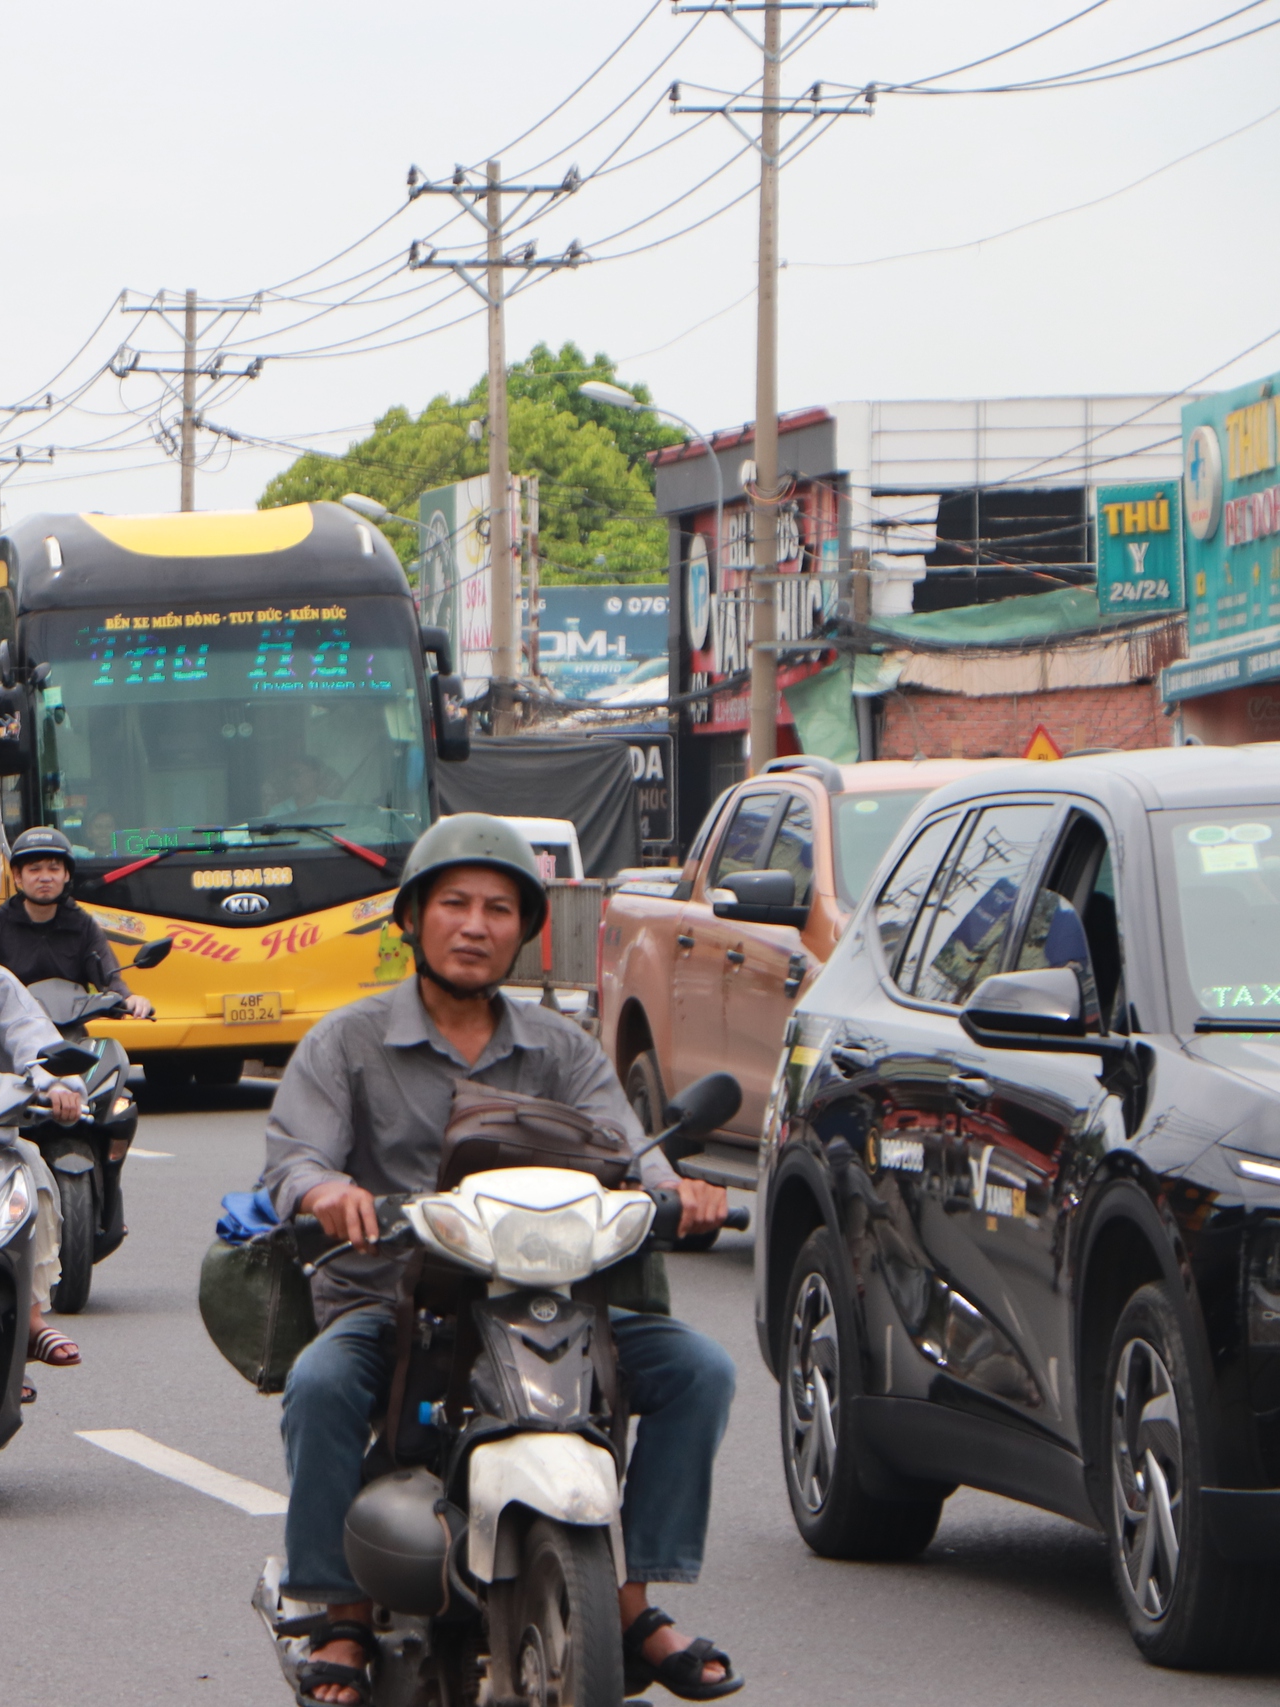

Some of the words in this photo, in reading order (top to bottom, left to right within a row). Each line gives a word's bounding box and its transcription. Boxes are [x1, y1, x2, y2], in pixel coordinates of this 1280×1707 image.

[1103, 493, 1170, 536] THÚ
[1129, 542, 1149, 574] Y
[1110, 579, 1170, 601] 24/24
[627, 596, 669, 612] 076
[105, 613, 131, 630] BẾN
[133, 617, 150, 629] XE
[185, 611, 221, 627] ĐÔNG
[229, 611, 254, 624] TUY
[256, 607, 283, 622] ĐỨC
[290, 605, 319, 621] KIẾN
[321, 604, 347, 620] ĐỨC
[574, 663, 622, 674] HYBRID
[629, 745, 665, 781] DA
[192, 869, 233, 889] 0905
[263, 866, 293, 886] 333
[229, 898, 262, 913] KIA
[165, 923, 242, 962] Thu
[261, 923, 323, 960] Hà
[240, 995, 263, 1007] 48F
[1212, 983, 1280, 1008] TAX
[230, 1009, 274, 1022] 003.24
